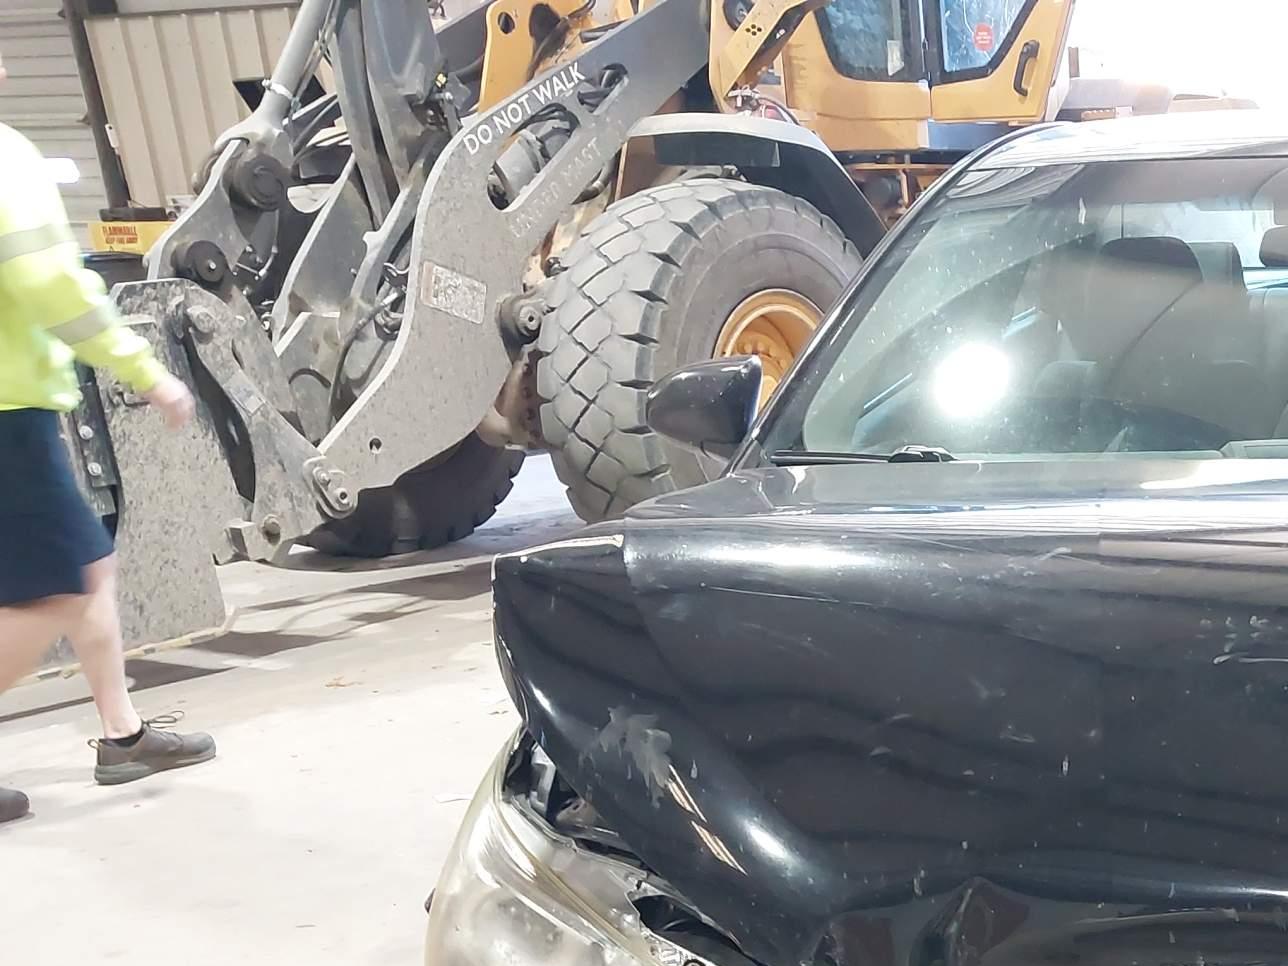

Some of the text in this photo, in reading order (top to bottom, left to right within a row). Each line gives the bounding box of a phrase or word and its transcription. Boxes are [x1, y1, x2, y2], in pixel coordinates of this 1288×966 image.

[463, 62, 586, 155] DO NOT WALK
